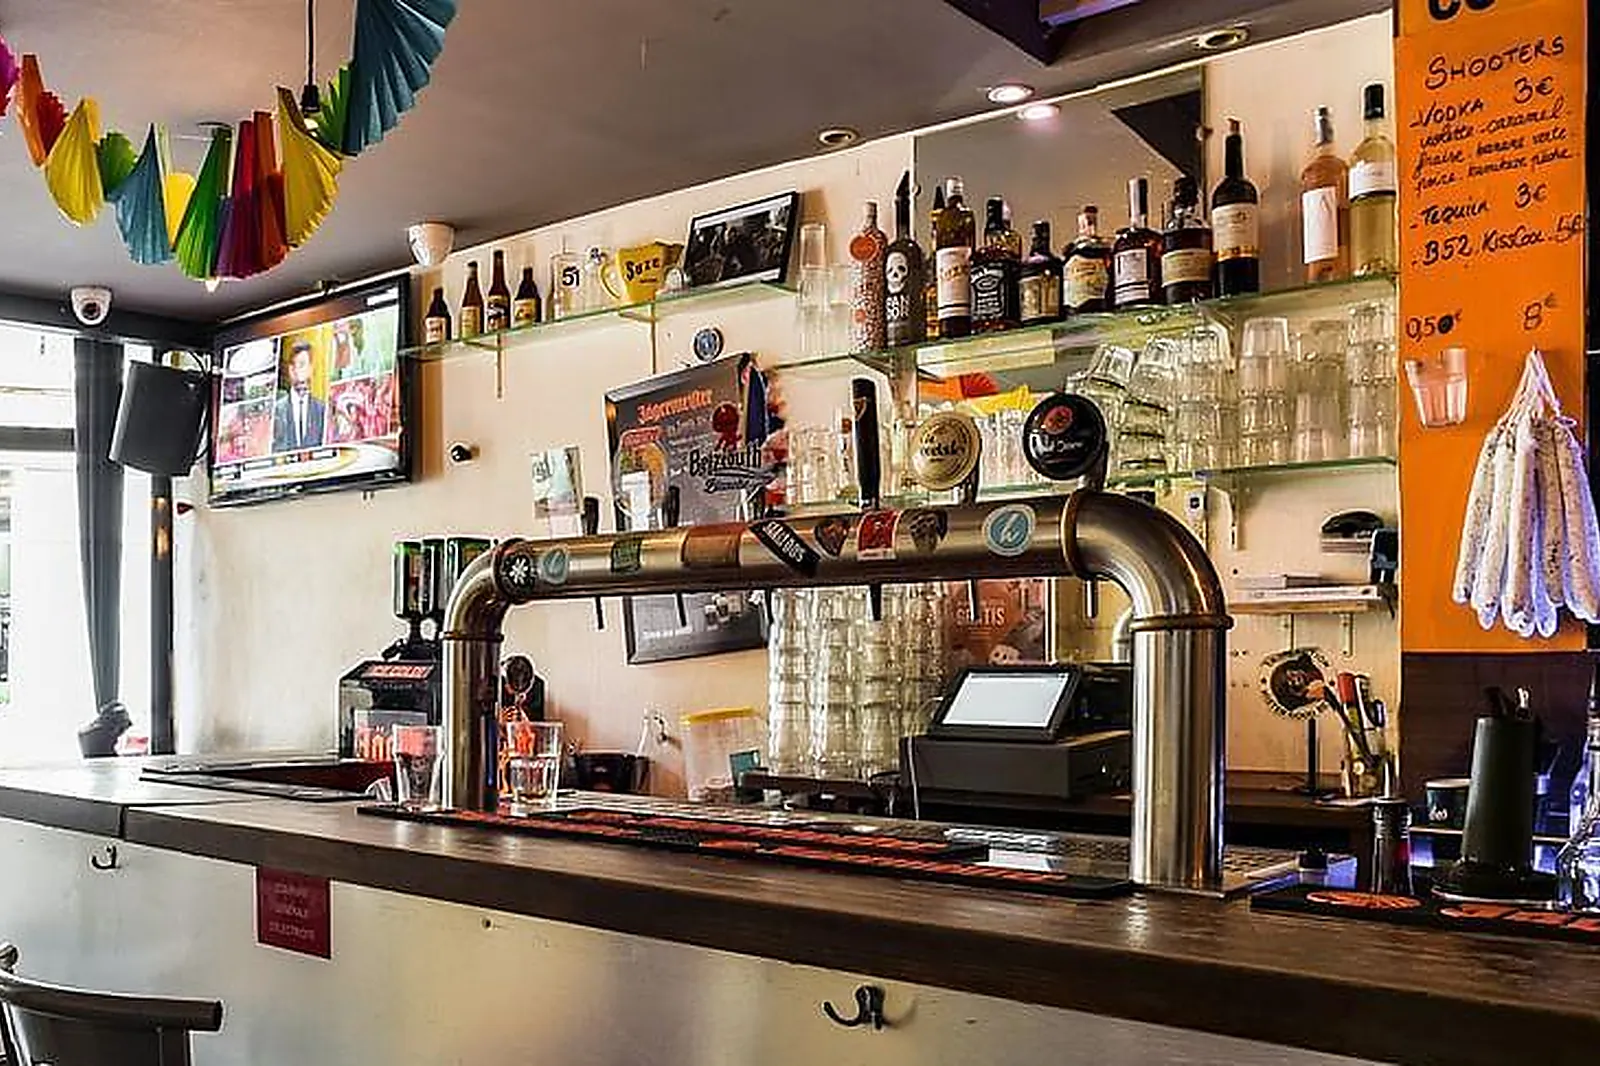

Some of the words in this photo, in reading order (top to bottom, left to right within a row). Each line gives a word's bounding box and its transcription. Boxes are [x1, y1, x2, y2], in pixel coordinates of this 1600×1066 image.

[1425, 36, 1565, 90] SHOOTERS
[1514, 76, 1554, 104] 3€
[562, 266, 580, 287] 51
